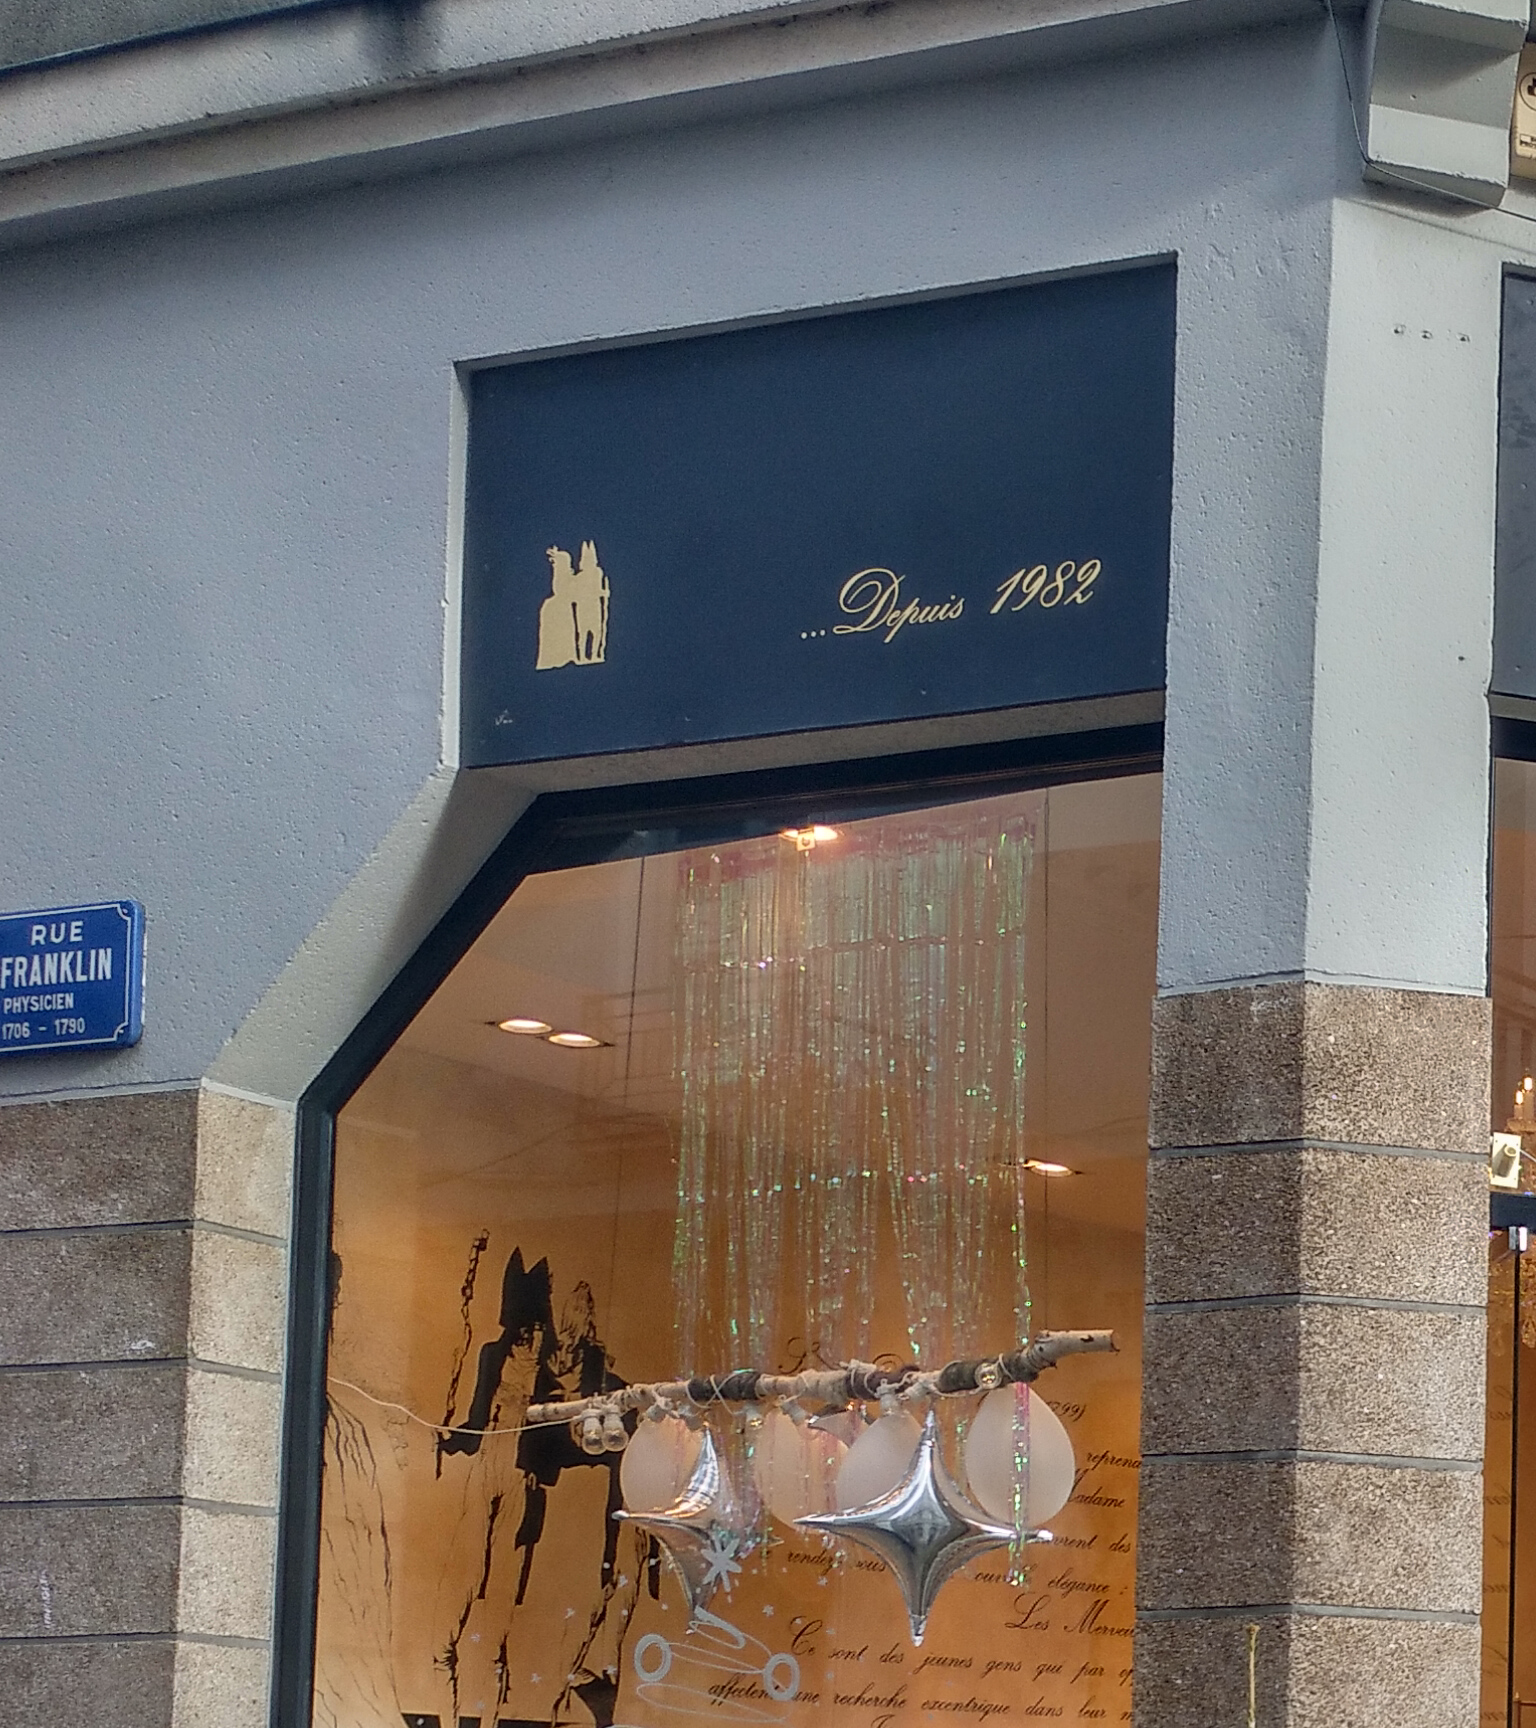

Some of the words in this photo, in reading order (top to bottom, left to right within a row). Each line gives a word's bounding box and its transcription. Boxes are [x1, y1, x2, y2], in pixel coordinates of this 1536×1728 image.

[989, 558, 1102, 615] 1982
[31, 920, 85, 946] RUE
[0, 947, 113, 990] FRANKLIN
[4, 992, 75, 1014] PHYSICIEN
[1, 1021, 31, 1041] 1706
[54, 1016, 86, 1037] 1790
[1108, 1533, 1131, 1554] des
[1004, 1591, 1050, 1630] Les
[827, 1644, 869, 1662] sont
[879, 1642, 904, 1664] des
[912, 1652, 973, 1676] jeunes
[981, 1659, 1022, 1680] gens
[1032, 1661, 1063, 1683] qui
[1070, 1661, 1104, 1685] par
[708, 1672, 783, 1707] affecten
[834, 1682, 908, 1710] recherche
[920, 1697, 1011, 1723] excentrique
[1025, 1696, 1064, 1718] dans
[1077, 1695, 1108, 1719] leur
